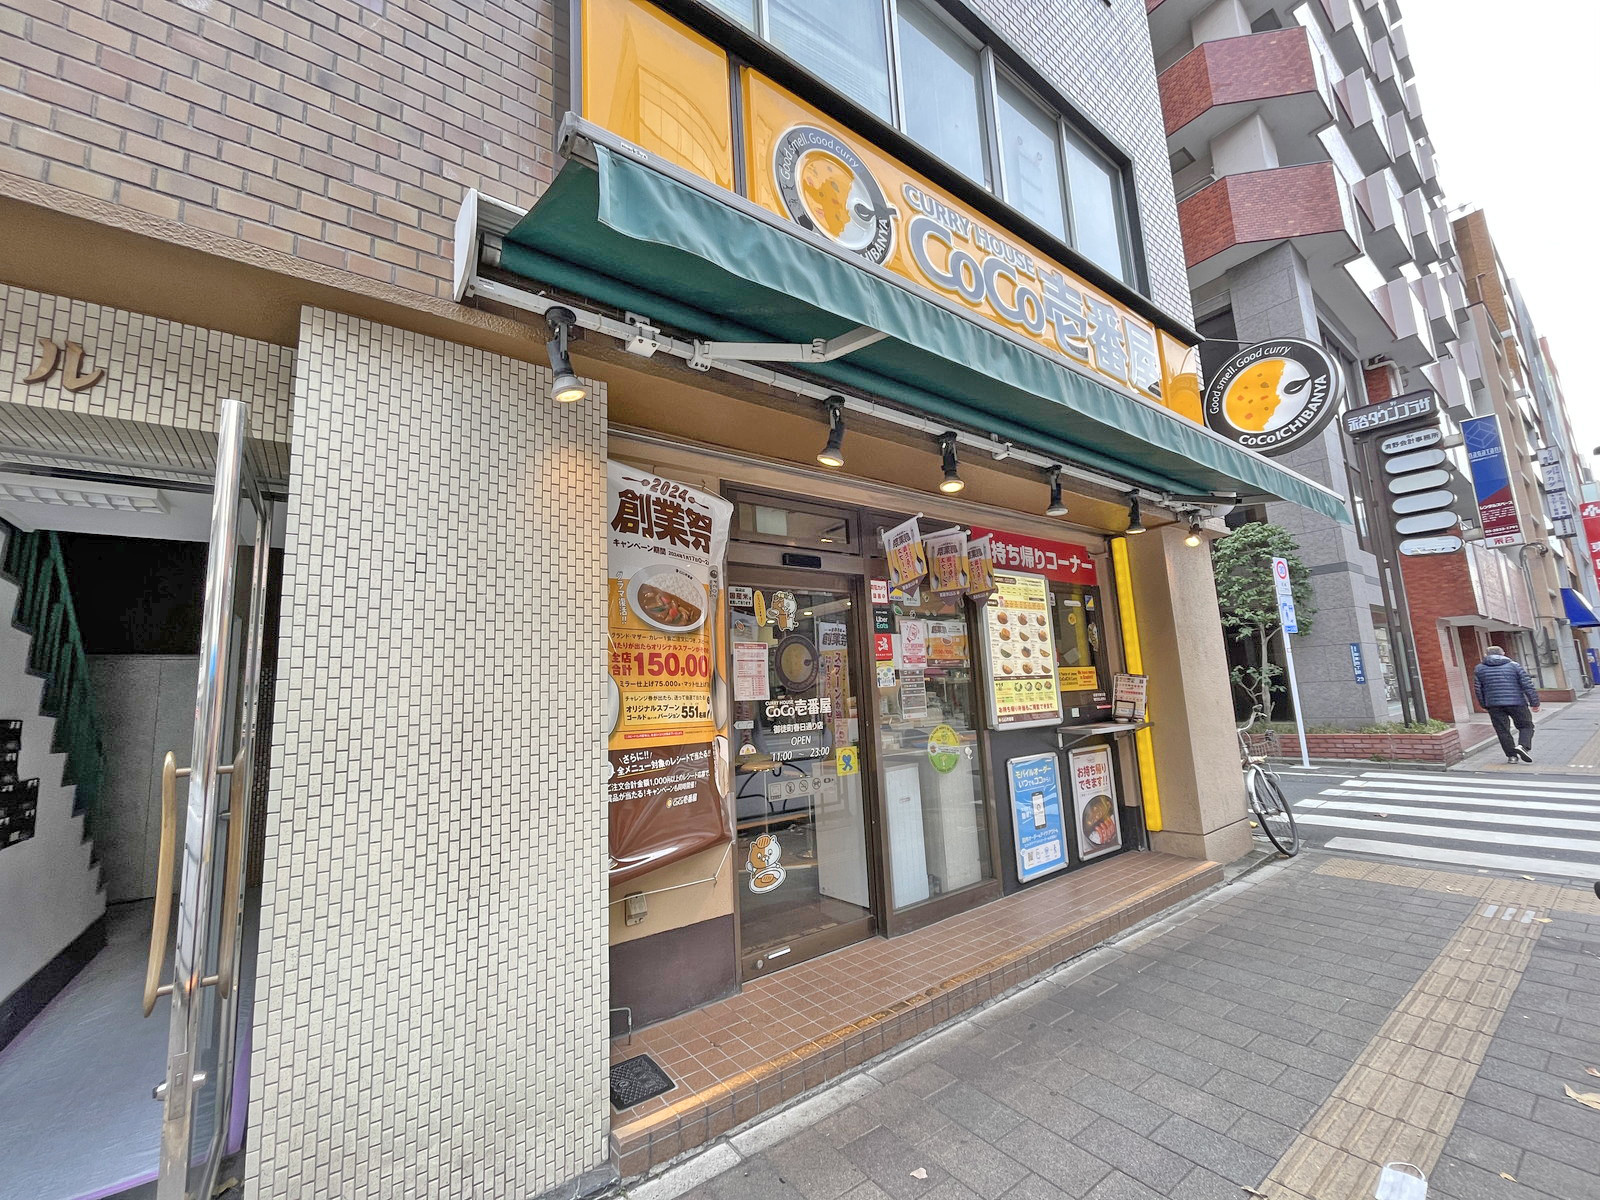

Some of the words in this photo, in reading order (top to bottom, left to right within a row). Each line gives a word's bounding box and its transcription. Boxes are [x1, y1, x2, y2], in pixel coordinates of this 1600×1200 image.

[780, 147, 793, 180] Good
[809, 132, 834, 150] Good
[834, 145, 860, 169] curry
[903, 184, 971, 238] CURRY
[973, 222, 1036, 277] HOUSE
[908, 215, 1162, 398] CoCo壱番屋
[23, 338, 105, 393] ル
[1209, 390, 1222, 415] Good
[1216, 367, 1238, 391] smell.
[1235, 347, 1263, 369] Good
[1263, 345, 1292, 356] curry
[1238, 374, 1327, 446] CoCoICHIBANYA
[649, 477, 690, 502] 2024
[611, 488, 714, 554] 創業祭
[612, 538, 667, 556] キャンペーン期間
[612, 652, 632, 664] 全店
[612, 664, 632, 676] 合計
[626, 704, 680, 713] オリジナルスプーン
[765, 697, 832, 718] CoCo壱番屋
[772, 720, 824, 734] 御徒町春日通り店
[790, 736, 812, 746] OPEN
[772, 751, 793, 762] 11:00
[809, 746, 830, 757] 23:00
[1015, 764, 1052, 779] モバイルオーダー
[1076, 763, 1107, 779] お持ち帰り
[1078, 775, 1109, 791] できます!!
